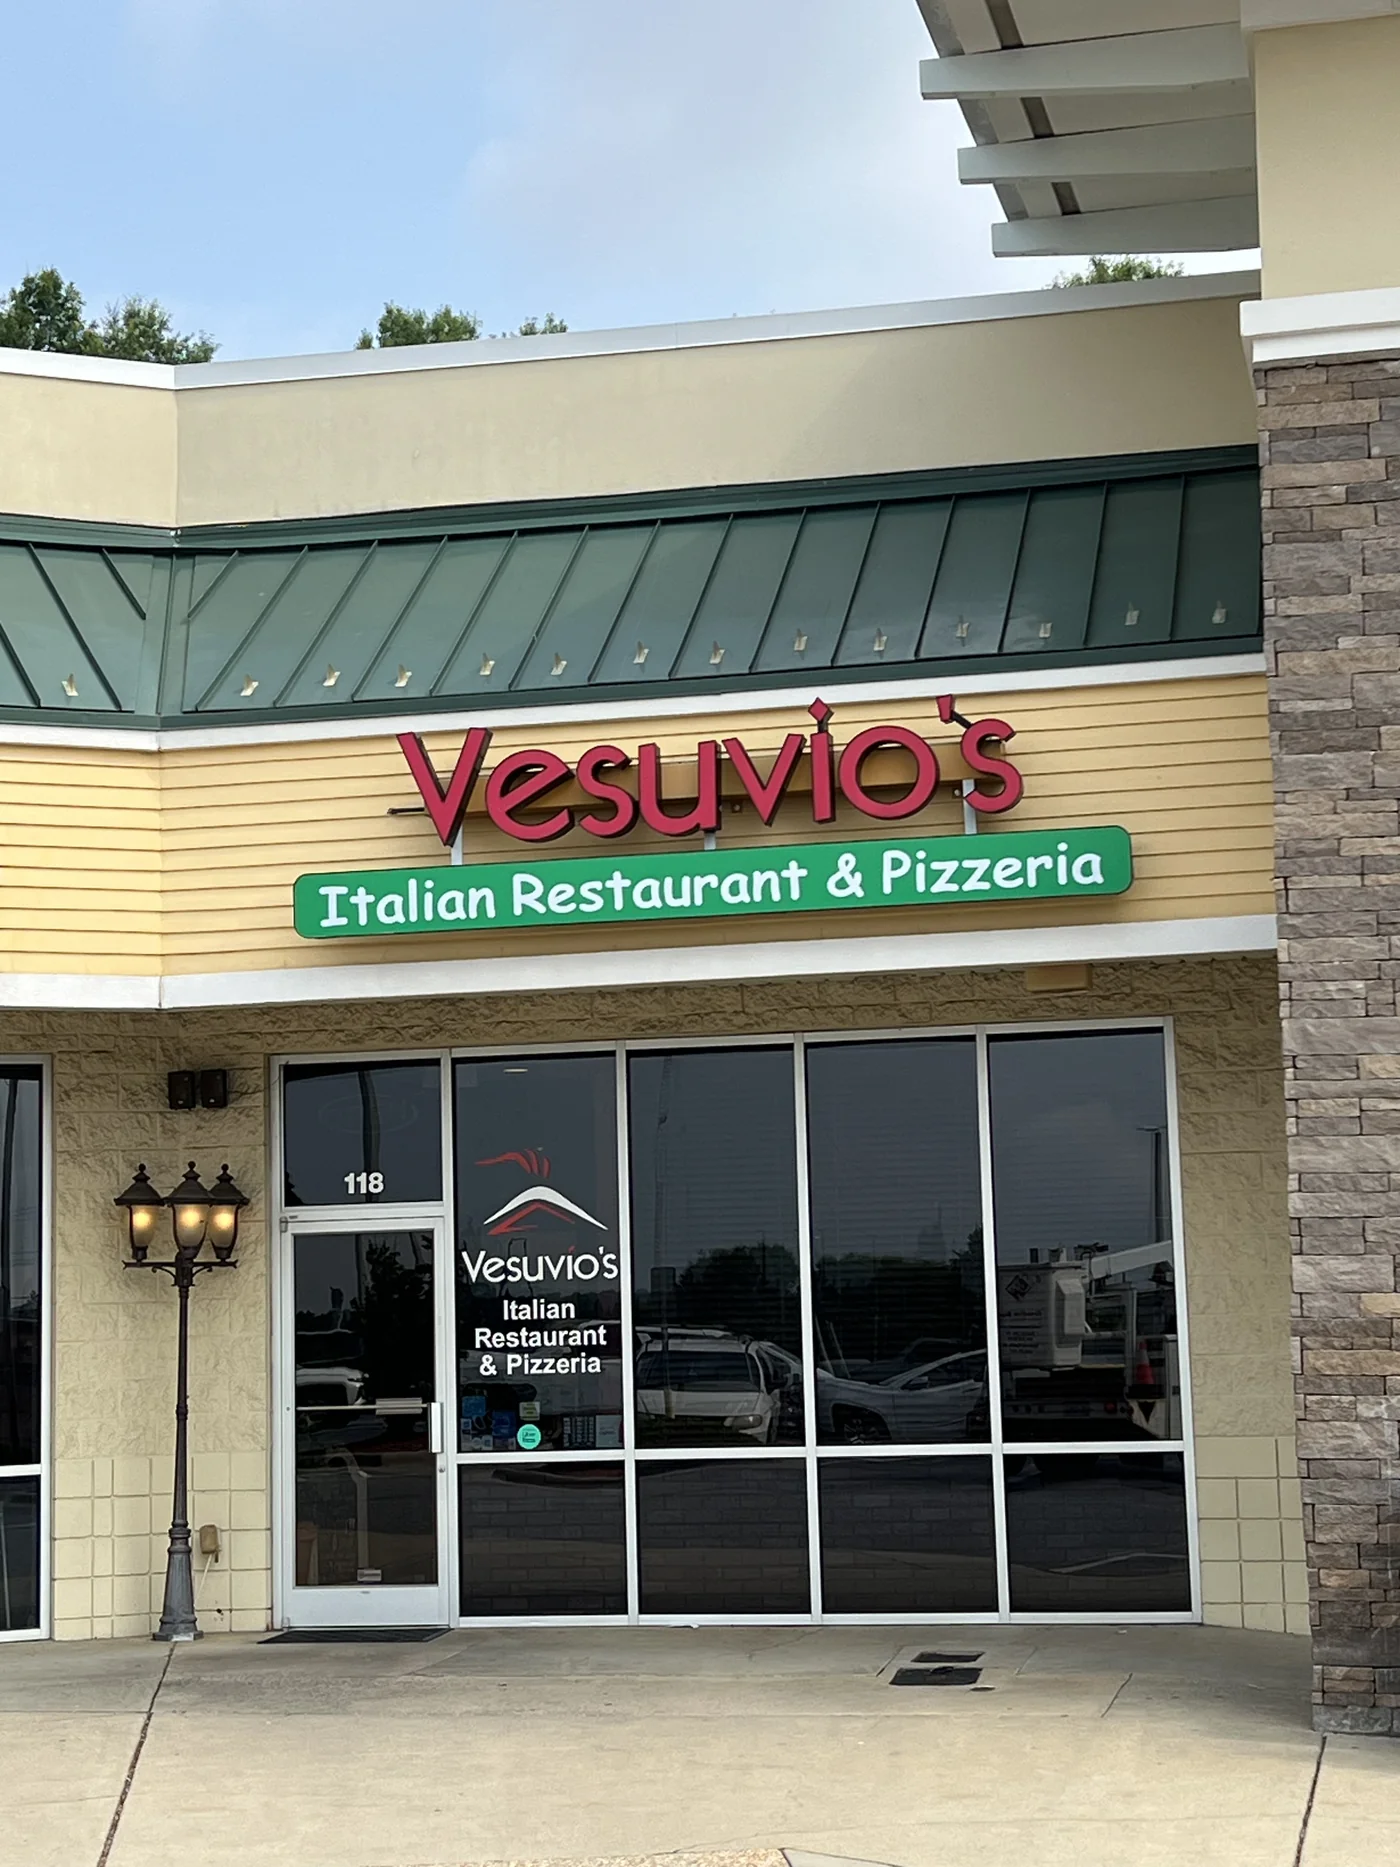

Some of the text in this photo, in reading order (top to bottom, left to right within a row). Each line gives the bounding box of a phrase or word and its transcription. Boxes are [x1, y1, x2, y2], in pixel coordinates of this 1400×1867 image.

[398, 695, 1024, 846] Vesuvio's
[318, 842, 1104, 929] Italian Restaurant & Pizzeria
[344, 1171, 384, 1194] 118
[461, 1245, 620, 1284] Vesuvio's
[503, 1298, 576, 1321] Italian
[474, 1324, 608, 1349] Restaurant
[479, 1352, 602, 1376] & Pizzeria
